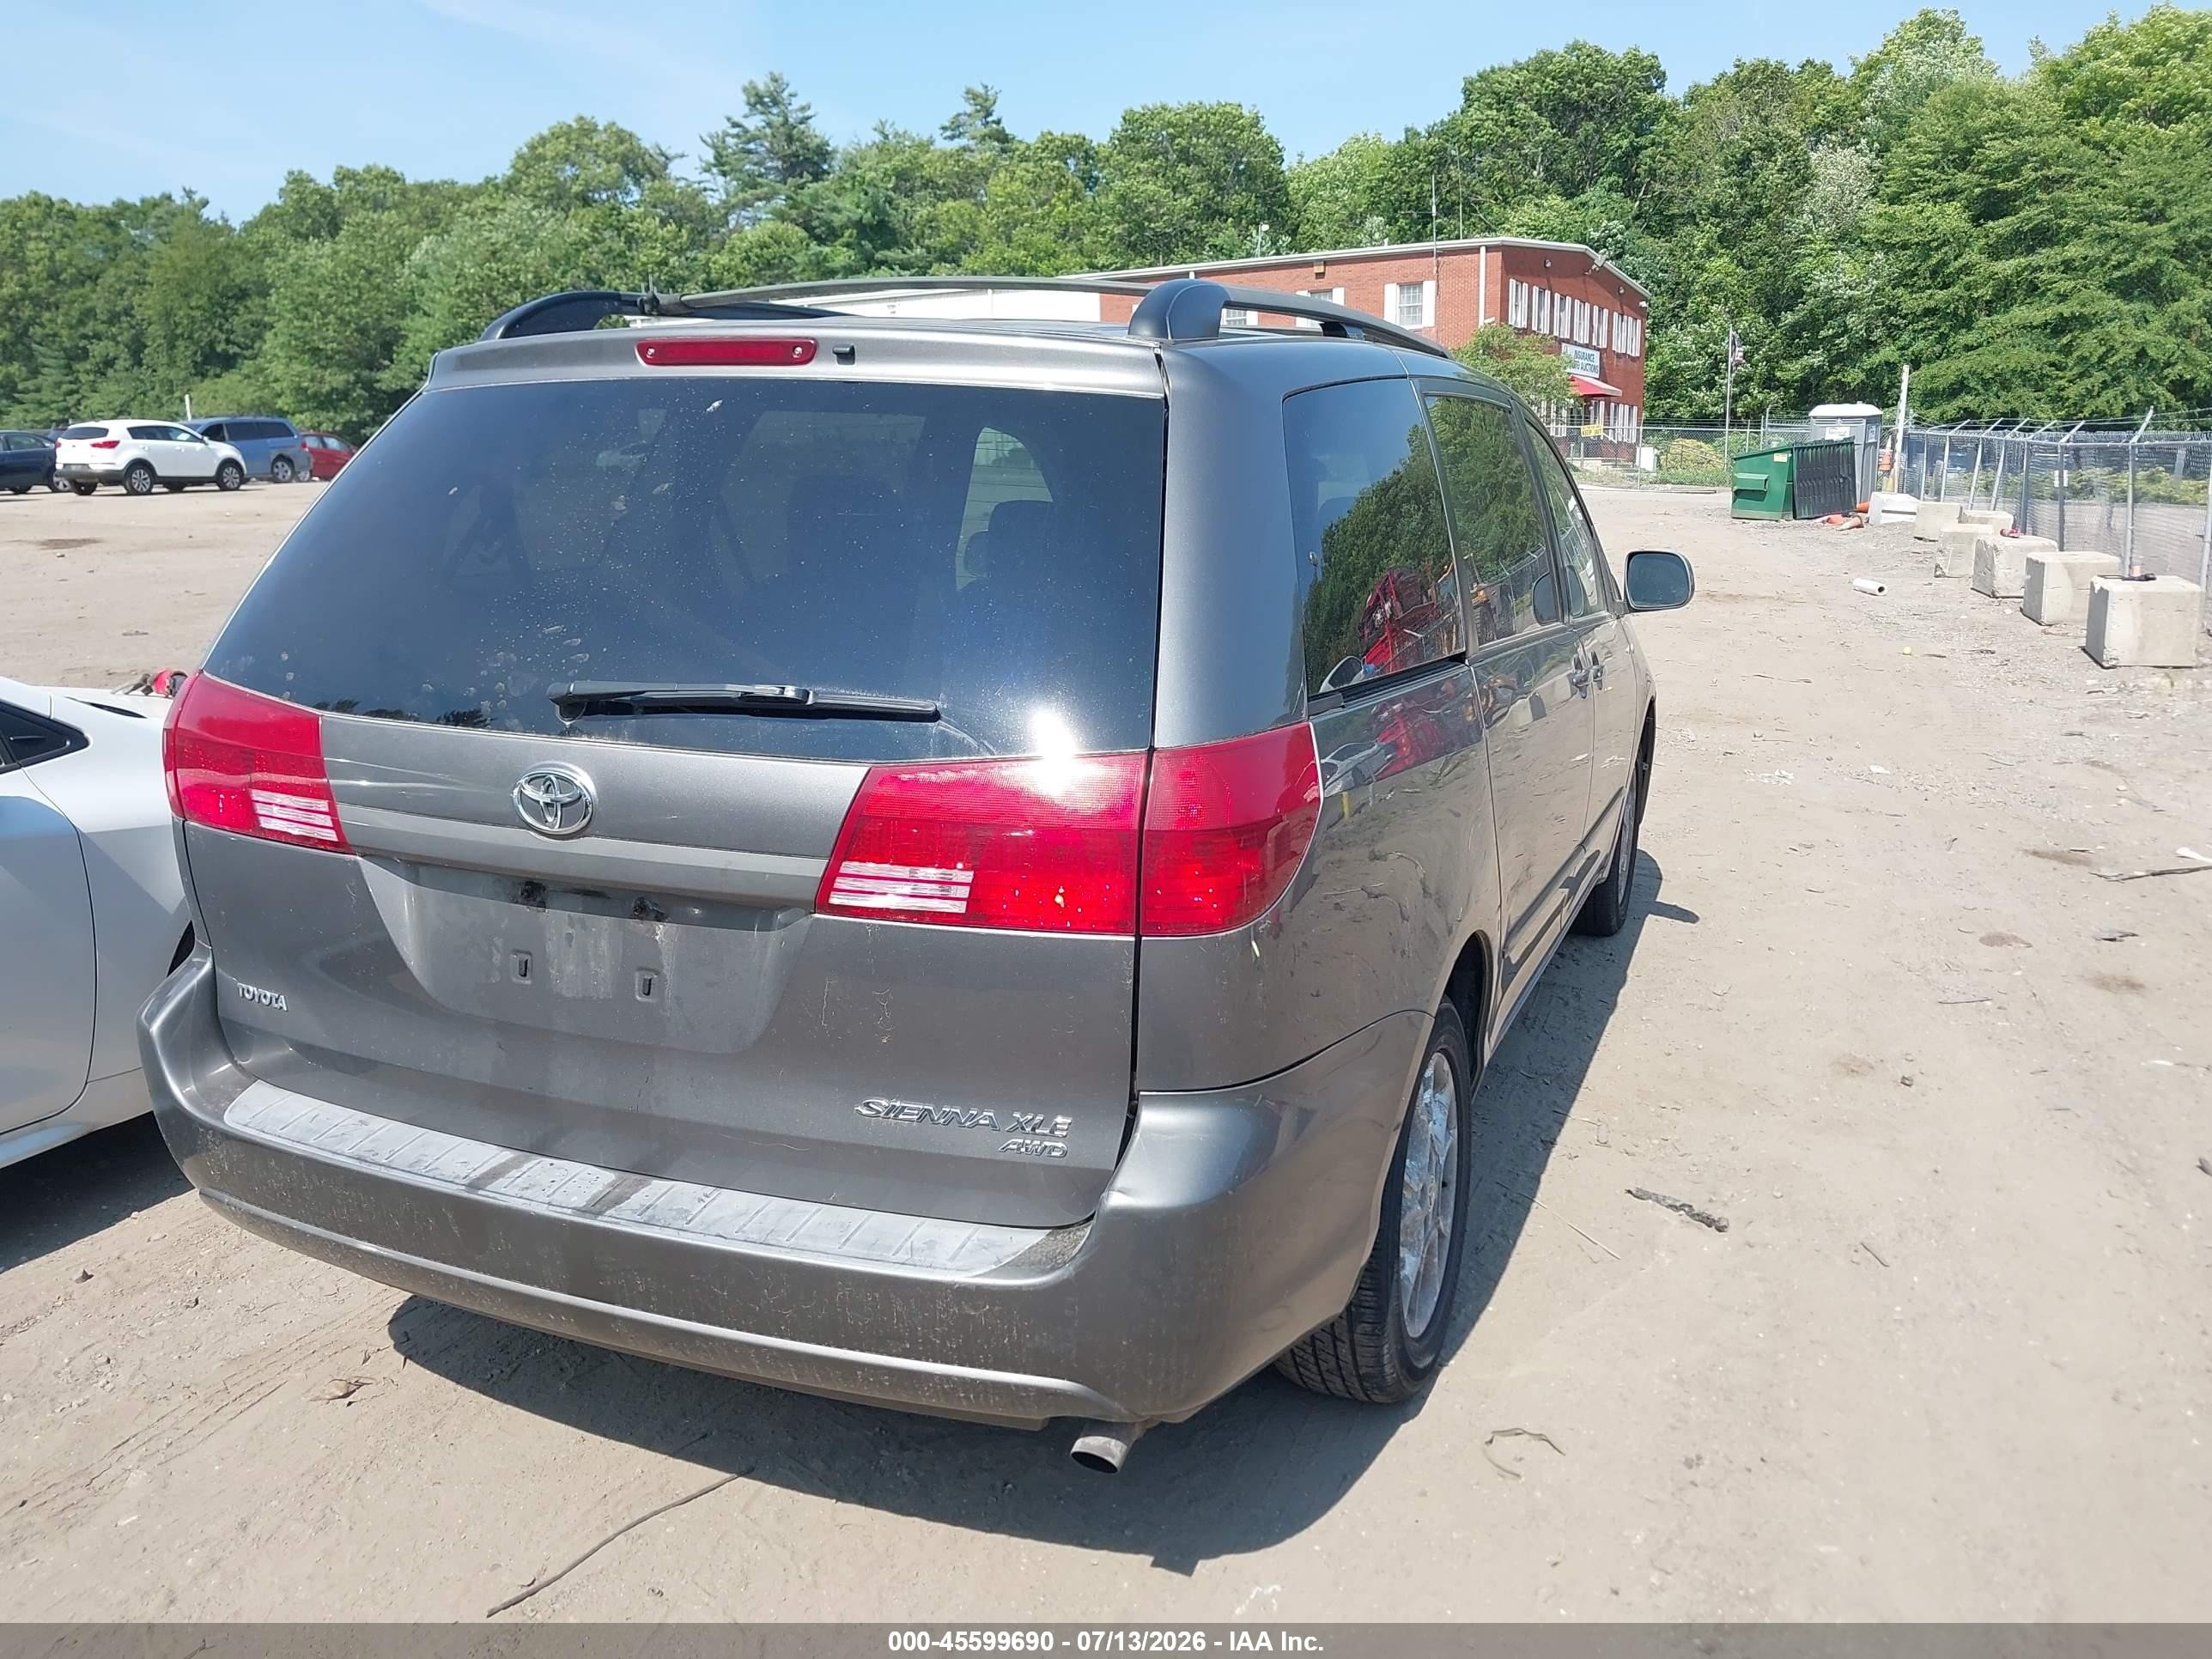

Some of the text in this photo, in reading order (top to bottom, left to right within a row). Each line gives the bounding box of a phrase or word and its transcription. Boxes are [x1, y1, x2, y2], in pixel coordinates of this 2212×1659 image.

[1574, 349, 1595, 363] INSURANCE
[1580, 362, 1599, 374] AUCTIONS
[236, 982, 289, 1012] TOYOTA
[854, 1097, 1073, 1138] SIENNA XLE
[998, 1138, 1068, 1158] AWD
